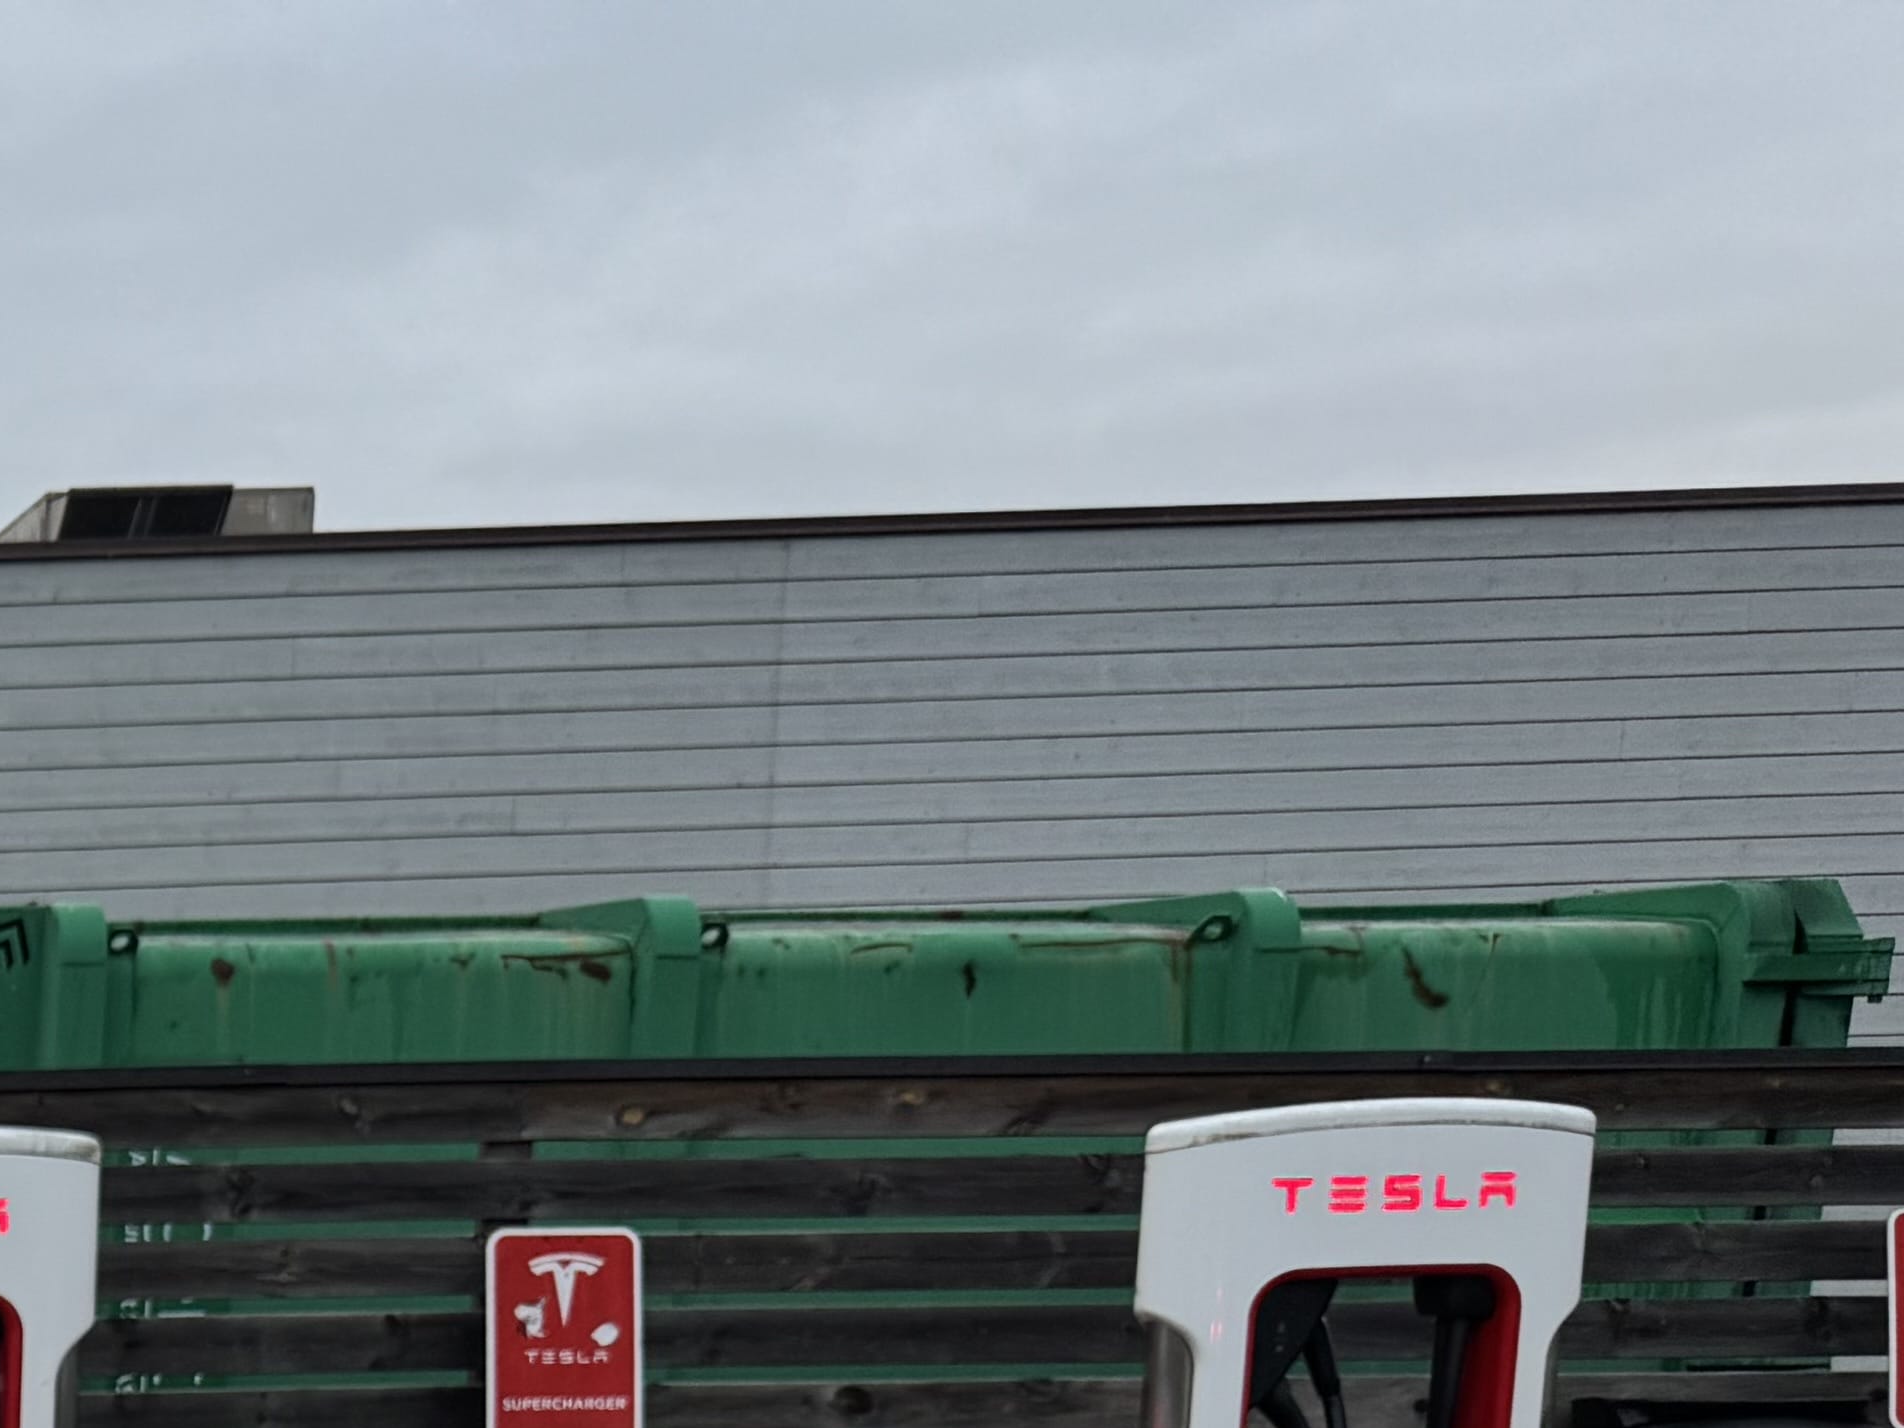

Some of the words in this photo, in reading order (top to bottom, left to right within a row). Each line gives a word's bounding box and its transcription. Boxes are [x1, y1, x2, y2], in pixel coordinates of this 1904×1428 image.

[1271, 1171, 1518, 1214] TESLA
[523, 1348, 609, 1365] TESLA
[502, 1395, 627, 1412] SUPERCHARGER
